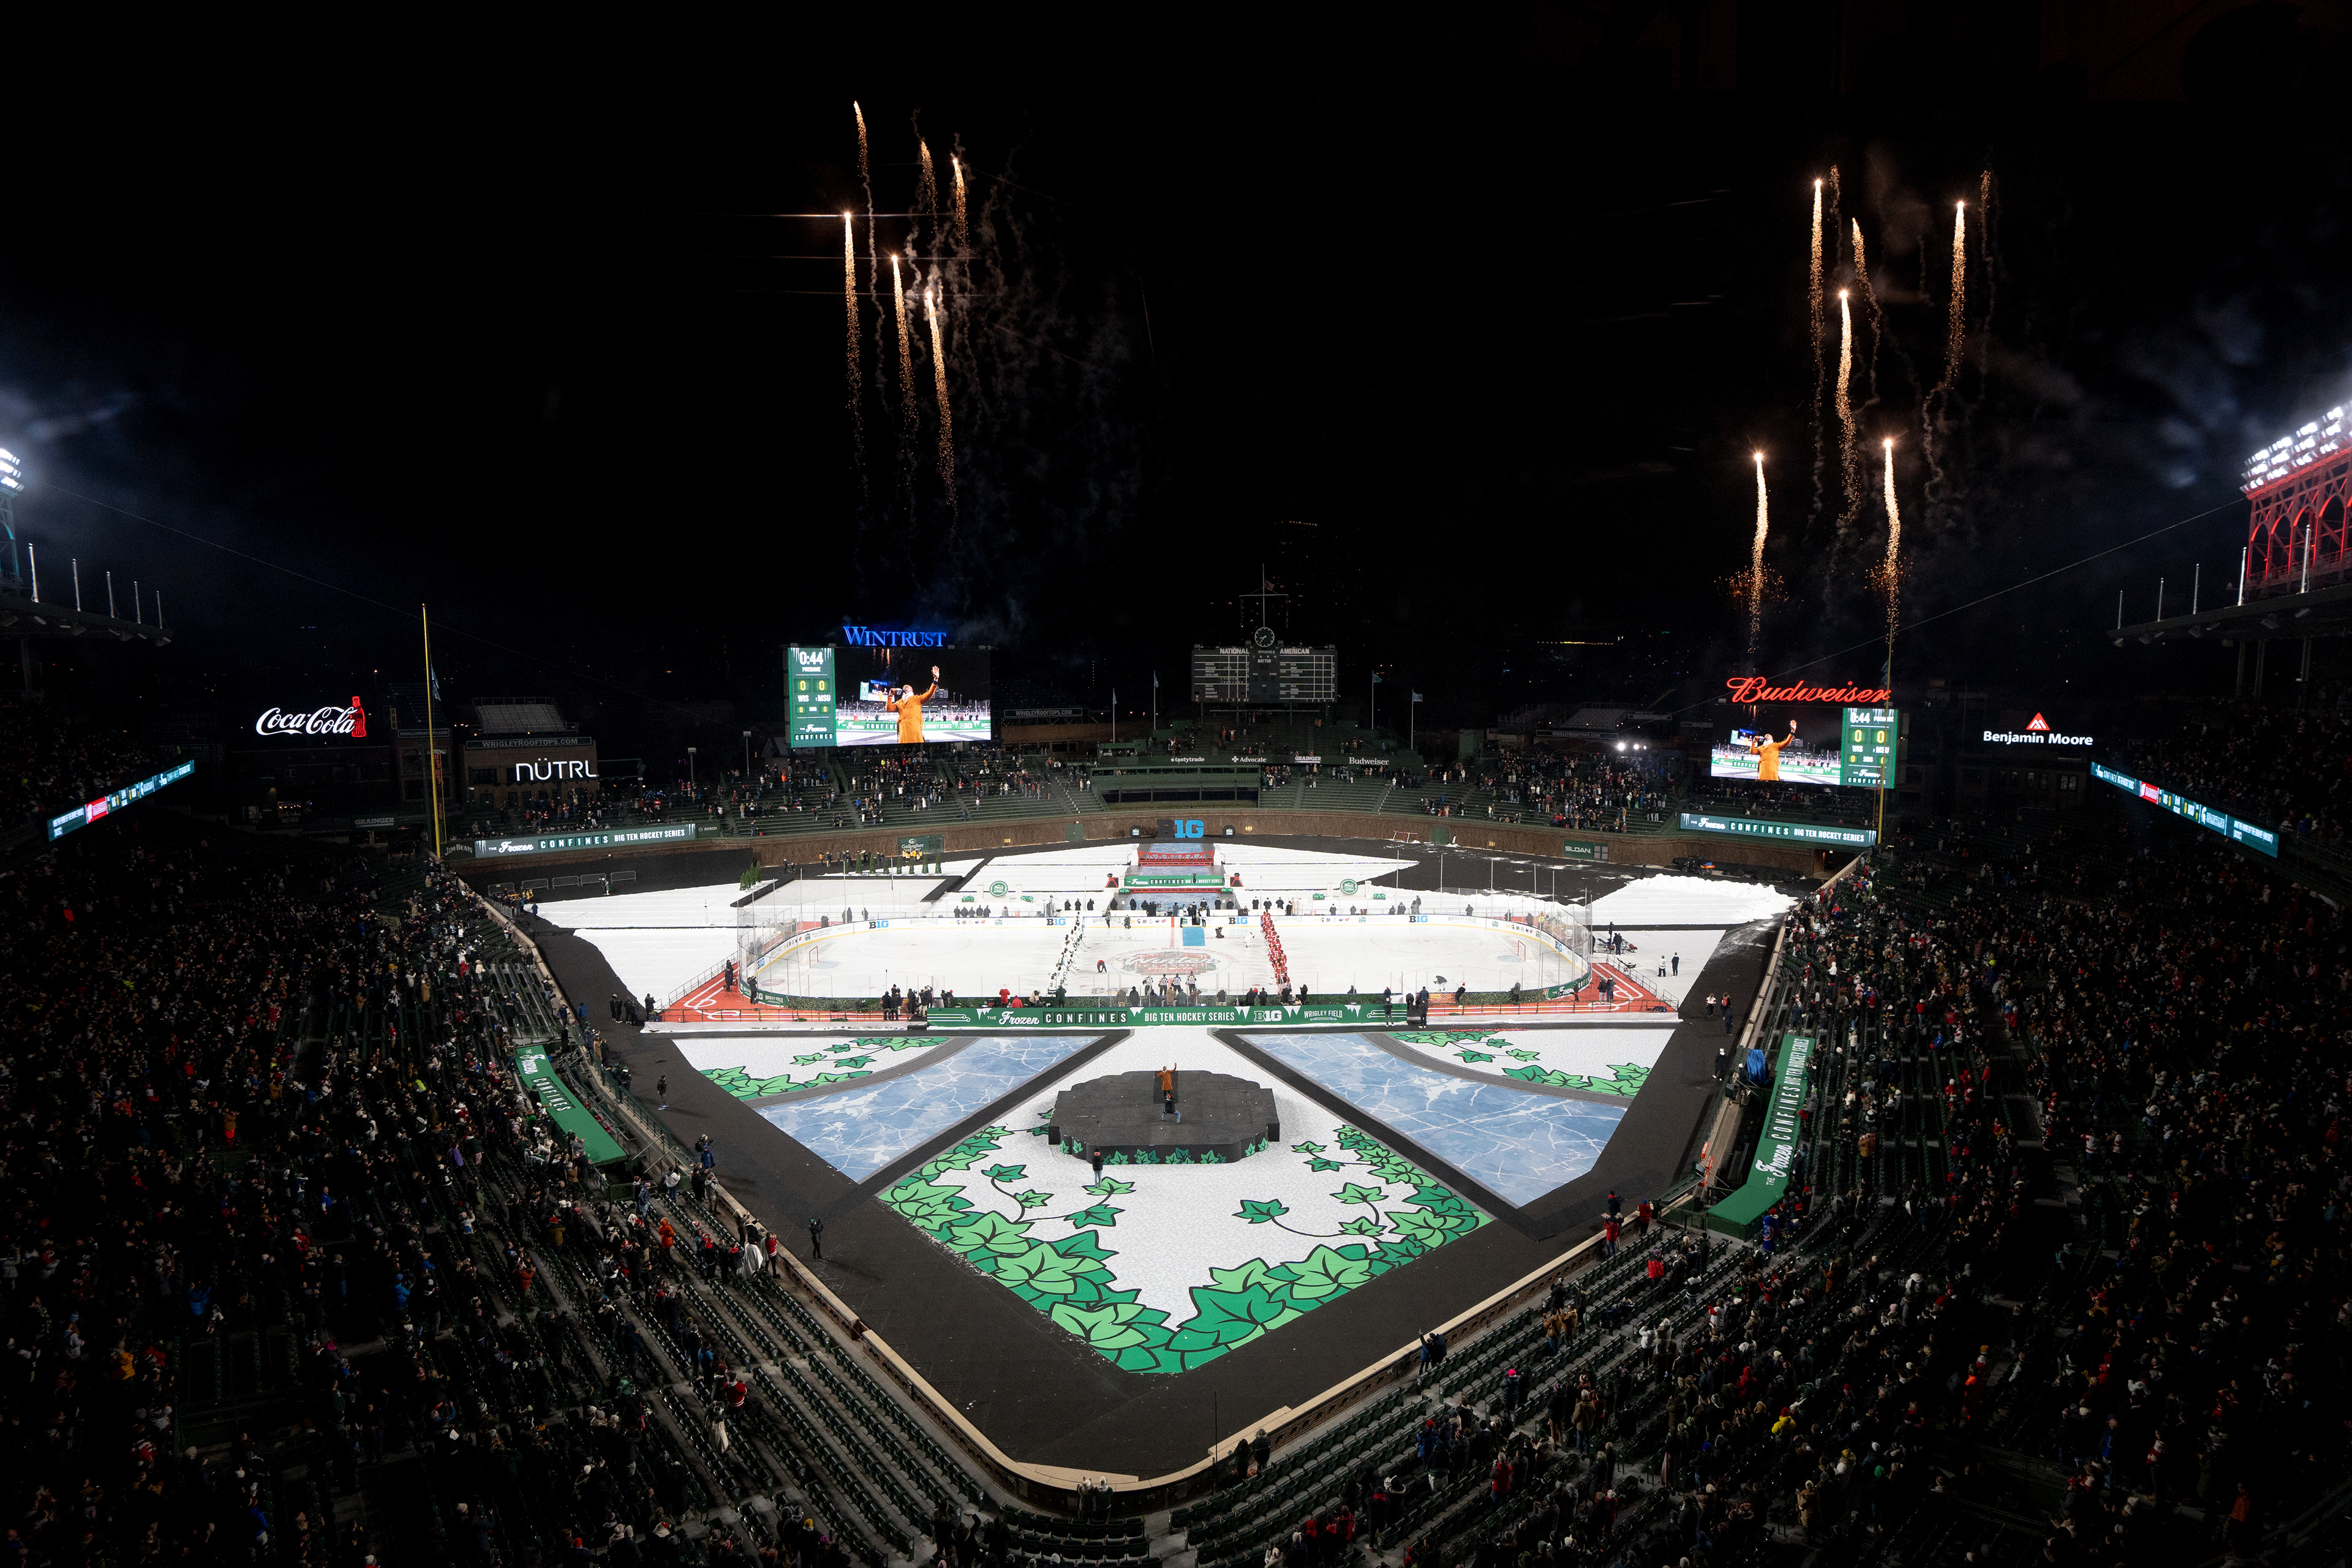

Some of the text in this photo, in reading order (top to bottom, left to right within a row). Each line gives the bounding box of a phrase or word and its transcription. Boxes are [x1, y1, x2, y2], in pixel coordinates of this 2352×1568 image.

[843, 626, 946, 647] WINTRUST
[799, 651, 823, 665] 0:44
[800, 680, 825, 692] 0 0
[1726, 676, 1891, 703] Budweiser
[255, 706, 360, 735] Coca-Cola
[1850, 712, 1871, 723] 0:44
[481, 737, 577, 748] WRIGLEYROOFTOPS.COM
[1854, 729, 1885, 744] 0 0
[1983, 730, 2094, 746] Benjamin Moore
[1698, 816, 1726, 831] Frozen
[1730, 821, 1789, 835] CONFINES
[1791, 827, 1801, 836] BIG
[1803, 829, 1815, 837] TEN
[1815, 830, 1839, 840] HOCKEY
[1839, 832, 1862, 842] SERIES
[499, 841, 534, 853] Frozen
[540, 835, 608, 849] CONFINES
[639, 831, 663, 840] HOCKEY
[665, 829, 685, 837] SERIES
[445, 844, 473, 856] JIM BEAM
[1118, 956, 1221, 965] Winter
[998, 1011, 1039, 1025] Frozen
[1046, 1013, 1126, 1023] CONFINES
[1145, 1012, 1157, 1022] BIG
[1159, 1012, 1174, 1022] TEN
[1177, 1012, 1206, 1021] HOCKEY
[1208, 1012, 1235, 1021] SERIES
[1304, 1010, 1327, 1019] WRIGLEY
[519, 1054, 546, 1074] Frozen
[533, 1078, 571, 1111] CONFINES
[1755, 1038, 1810, 1186] THE Frozen CONFINES BIG TEN HOCKEY SERIES
